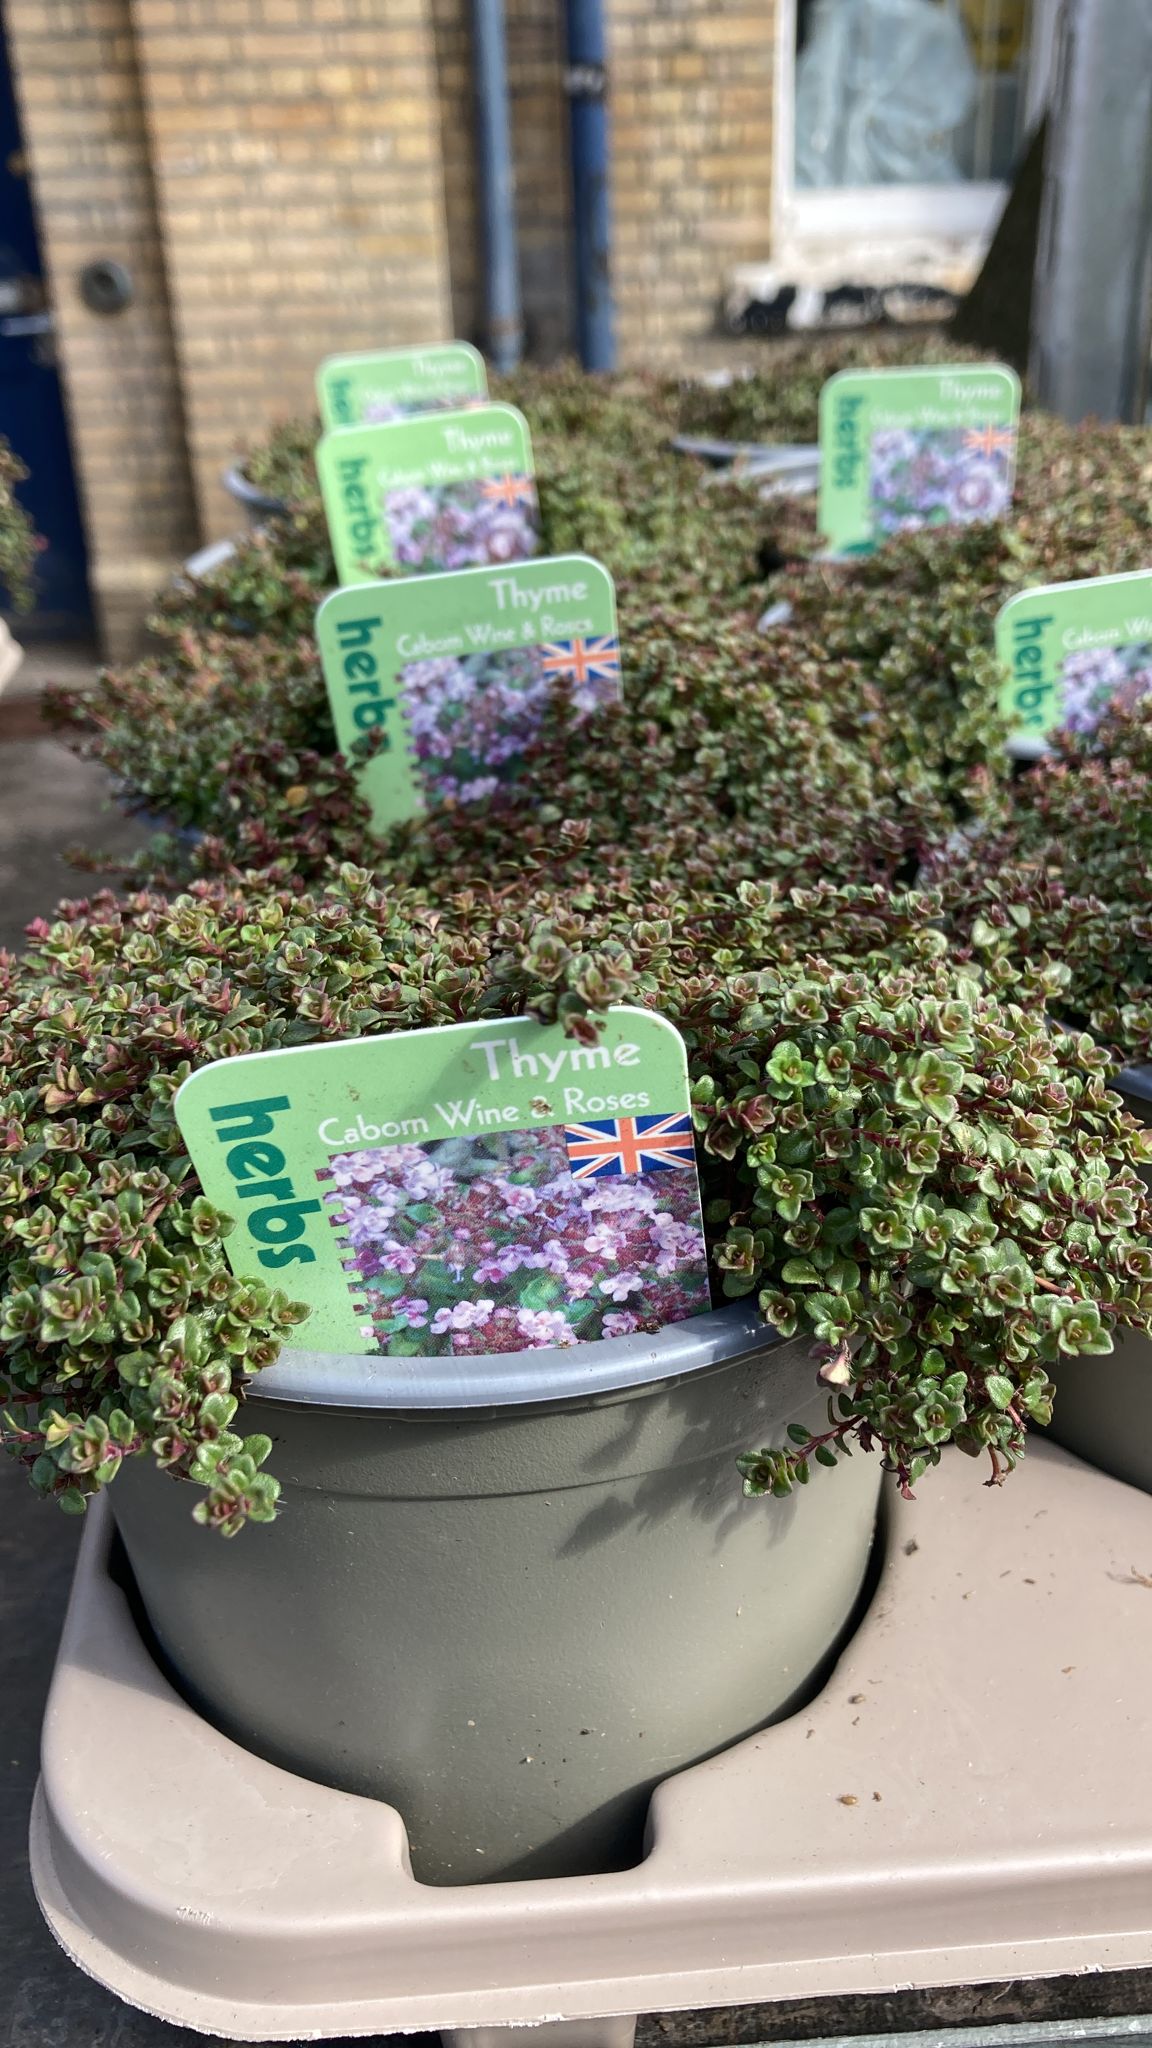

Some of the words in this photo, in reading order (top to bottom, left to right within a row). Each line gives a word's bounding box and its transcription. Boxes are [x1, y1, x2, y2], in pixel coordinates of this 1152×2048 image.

[444, 426, 513, 454] Thyme
[338, 458, 377, 556] herbs
[488, 577, 588, 613] Thyme
[464, 622, 516, 646] Wine
[521, 620, 536, 641] &
[470, 1037, 641, 1083] Thyme
[434, 1098, 519, 1130] Wine
[530, 1095, 555, 1119] &
[563, 1086, 651, 1115] Roses
[209, 1095, 322, 1269] herbs
